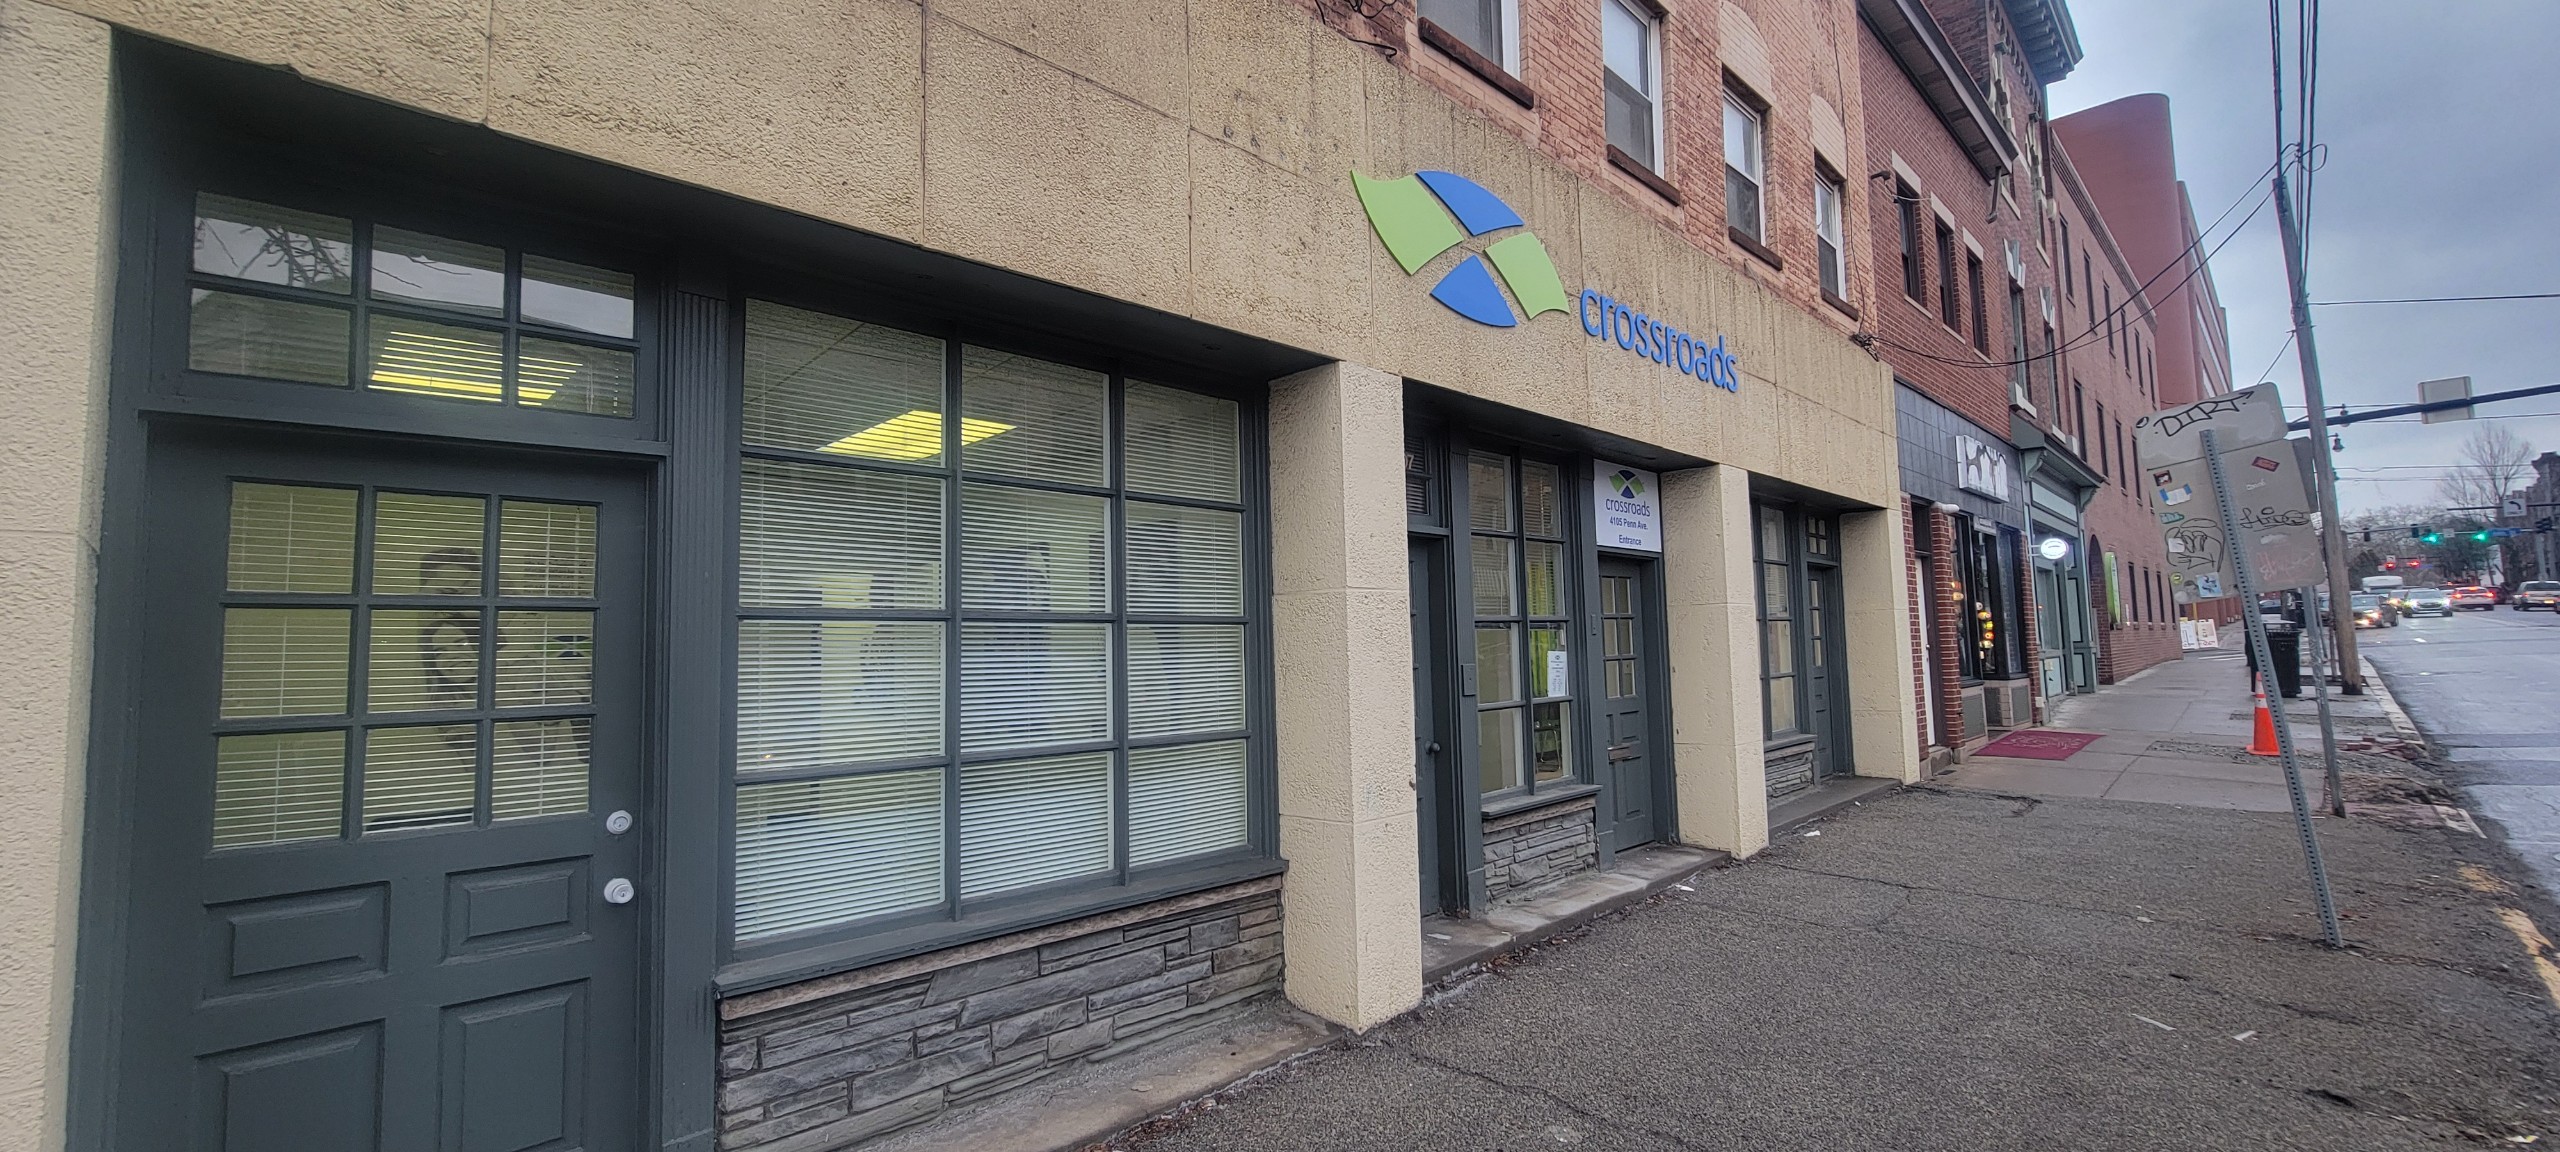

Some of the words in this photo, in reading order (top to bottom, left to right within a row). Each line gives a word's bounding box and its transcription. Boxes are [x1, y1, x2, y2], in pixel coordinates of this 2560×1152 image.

[1580, 289, 1738, 393] crossroads
[1605, 498, 1651, 517] crossroads
[1609, 516, 1623, 527] 4105
[1623, 518, 1637, 529] Penn
[1637, 520, 1649, 530] Ave.
[1618, 534, 1642, 546] Entrance
